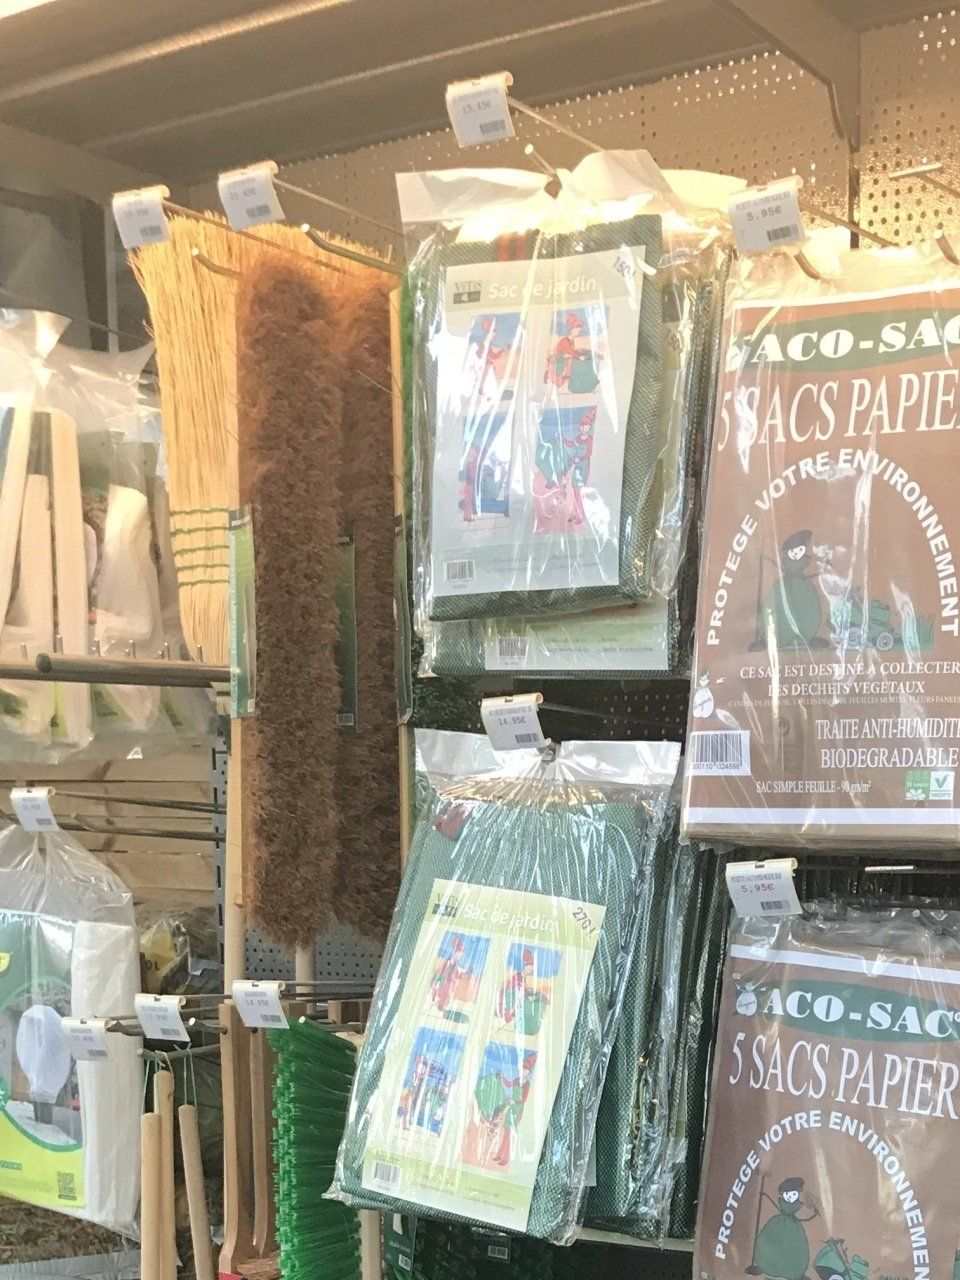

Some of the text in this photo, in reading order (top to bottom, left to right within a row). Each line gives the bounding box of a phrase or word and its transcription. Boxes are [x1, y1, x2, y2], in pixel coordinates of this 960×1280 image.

[488, 283, 519, 300] Sac
[718, 392, 732, 451] 5
[739, 379, 838, 445] SACS
[707, 448, 959, 646] PROTEGE VOTRE ENVIRONNEMENT
[740, 660, 960, 680] CE EST COLLECTER
[791, 681, 925, 696] DECHETS VEGETAUX
[816, 718, 859, 740] TRAITE
[820, 747, 959, 769] BIODEGRADABLE
[756, 780, 836, 793] SAC SIMPLE FEUILLE
[741, 883, 775, 894] 5,95€
[729, 1032, 960, 1120] 5 SACS PAPIER
[715, 1150, 760, 1260] PROTEGE
[758, 1109, 822, 1152] VOTRE
